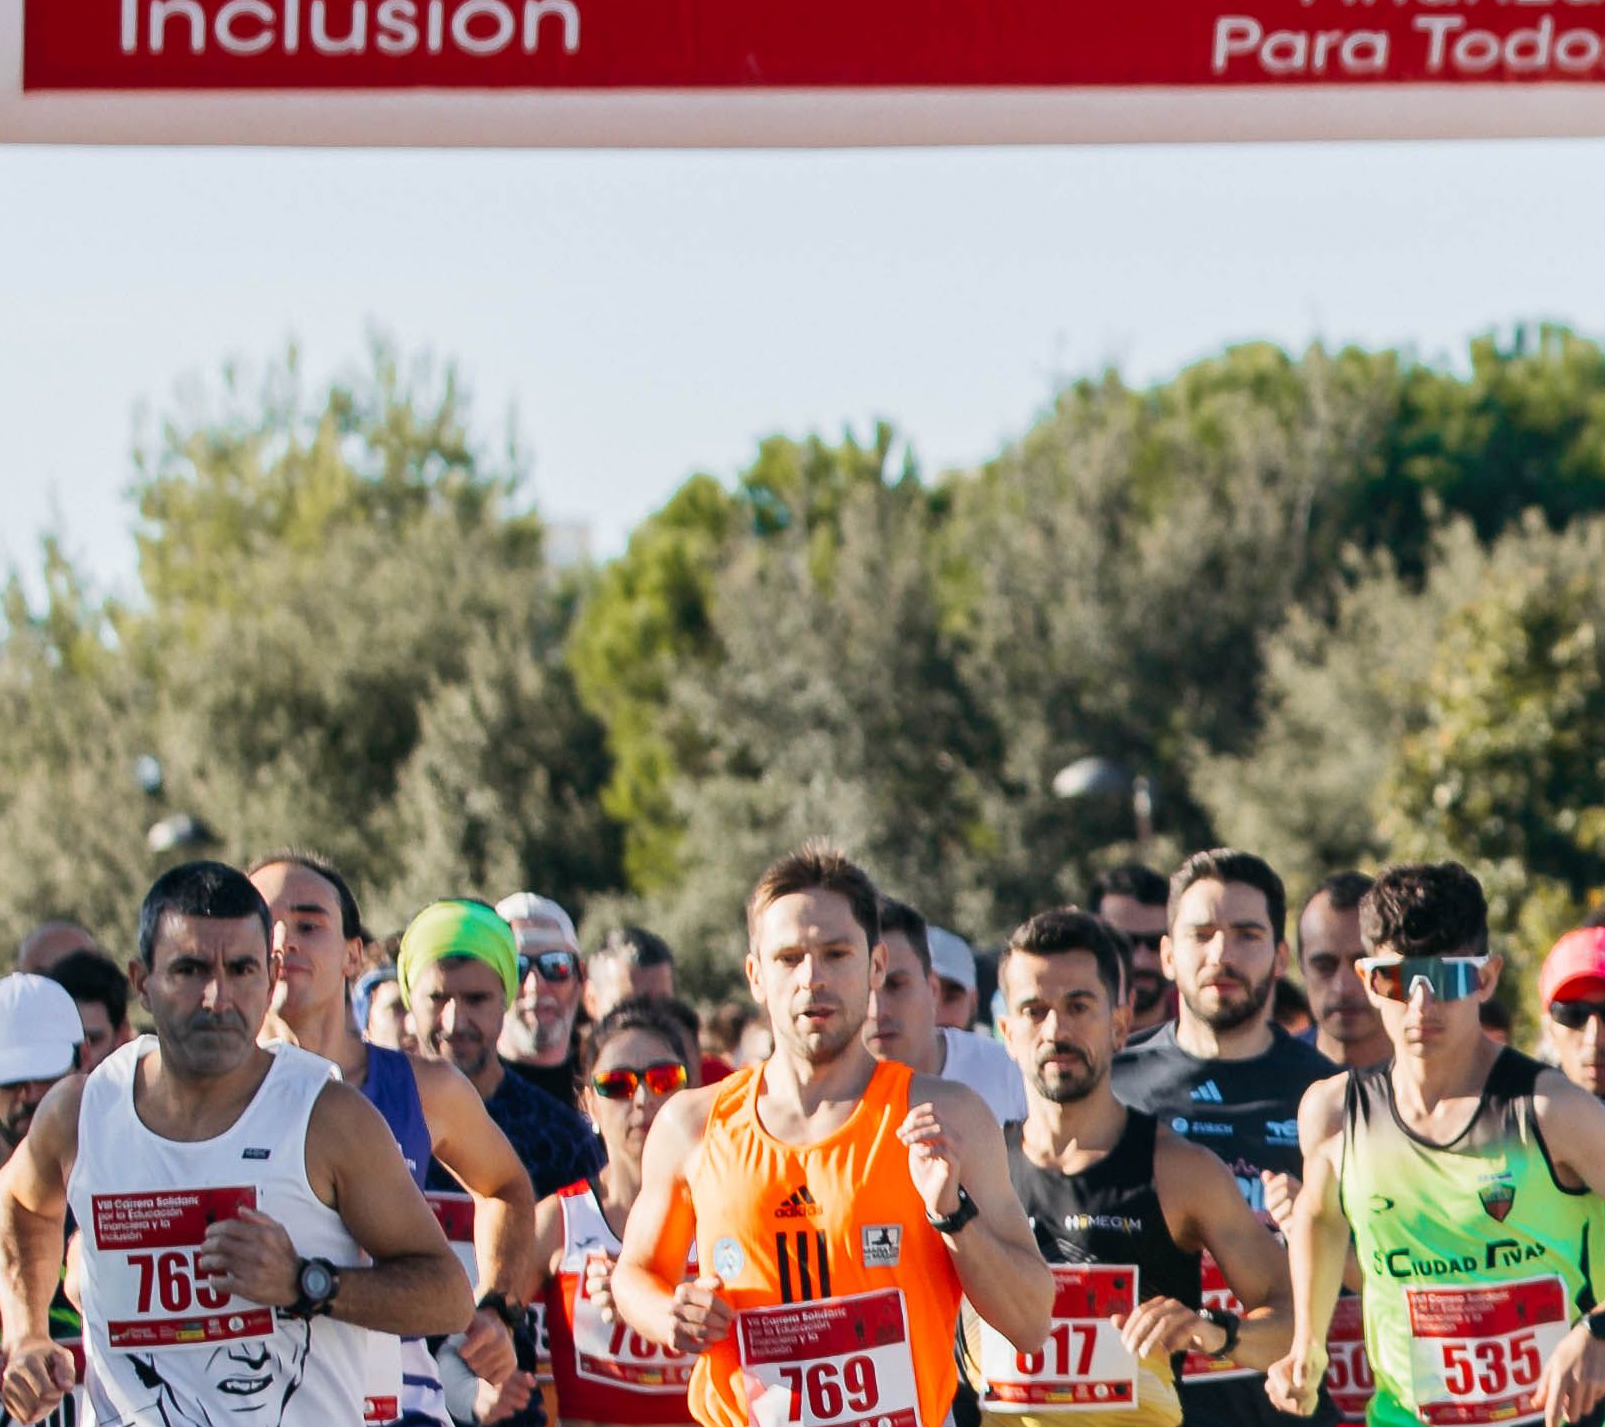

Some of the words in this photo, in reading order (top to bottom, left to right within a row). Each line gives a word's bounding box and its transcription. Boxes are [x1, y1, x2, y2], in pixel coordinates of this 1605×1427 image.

[1213, 17, 1388, 73] Para
[127, 1250, 232, 1314] 765
[778, 1355, 880, 1422] 769
[1441, 1332, 1542, 1396] 535
